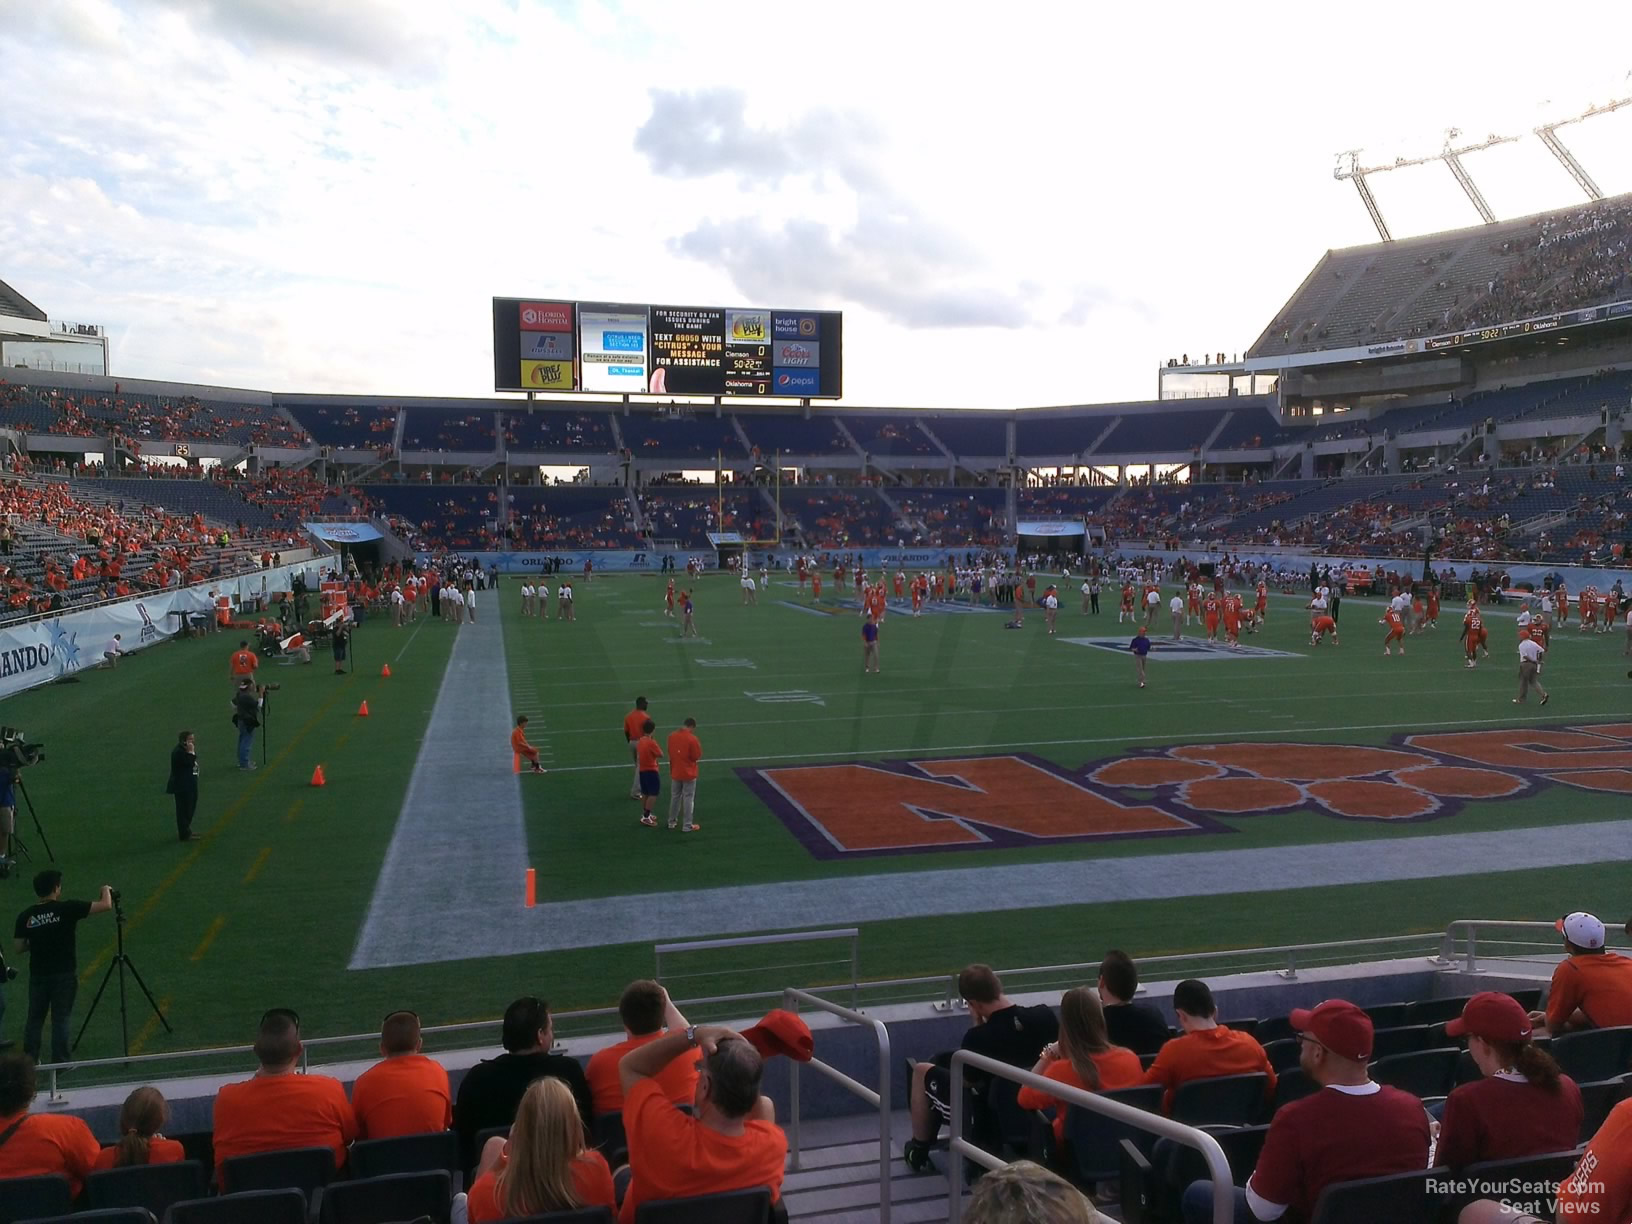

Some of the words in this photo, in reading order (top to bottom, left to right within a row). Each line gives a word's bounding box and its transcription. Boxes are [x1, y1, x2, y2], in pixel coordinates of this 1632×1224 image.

[776, 318, 797, 326] bright
[670, 350, 706, 358] MESSAGE
[758, 346, 765, 356] 0
[674, 358, 721, 366] ASSISTANCE
[791, 377, 814, 386] pepsi
[758, 384, 765, 394] 0
[178, 446, 188, 455] 25
[1207, 602, 1216, 611] 54
